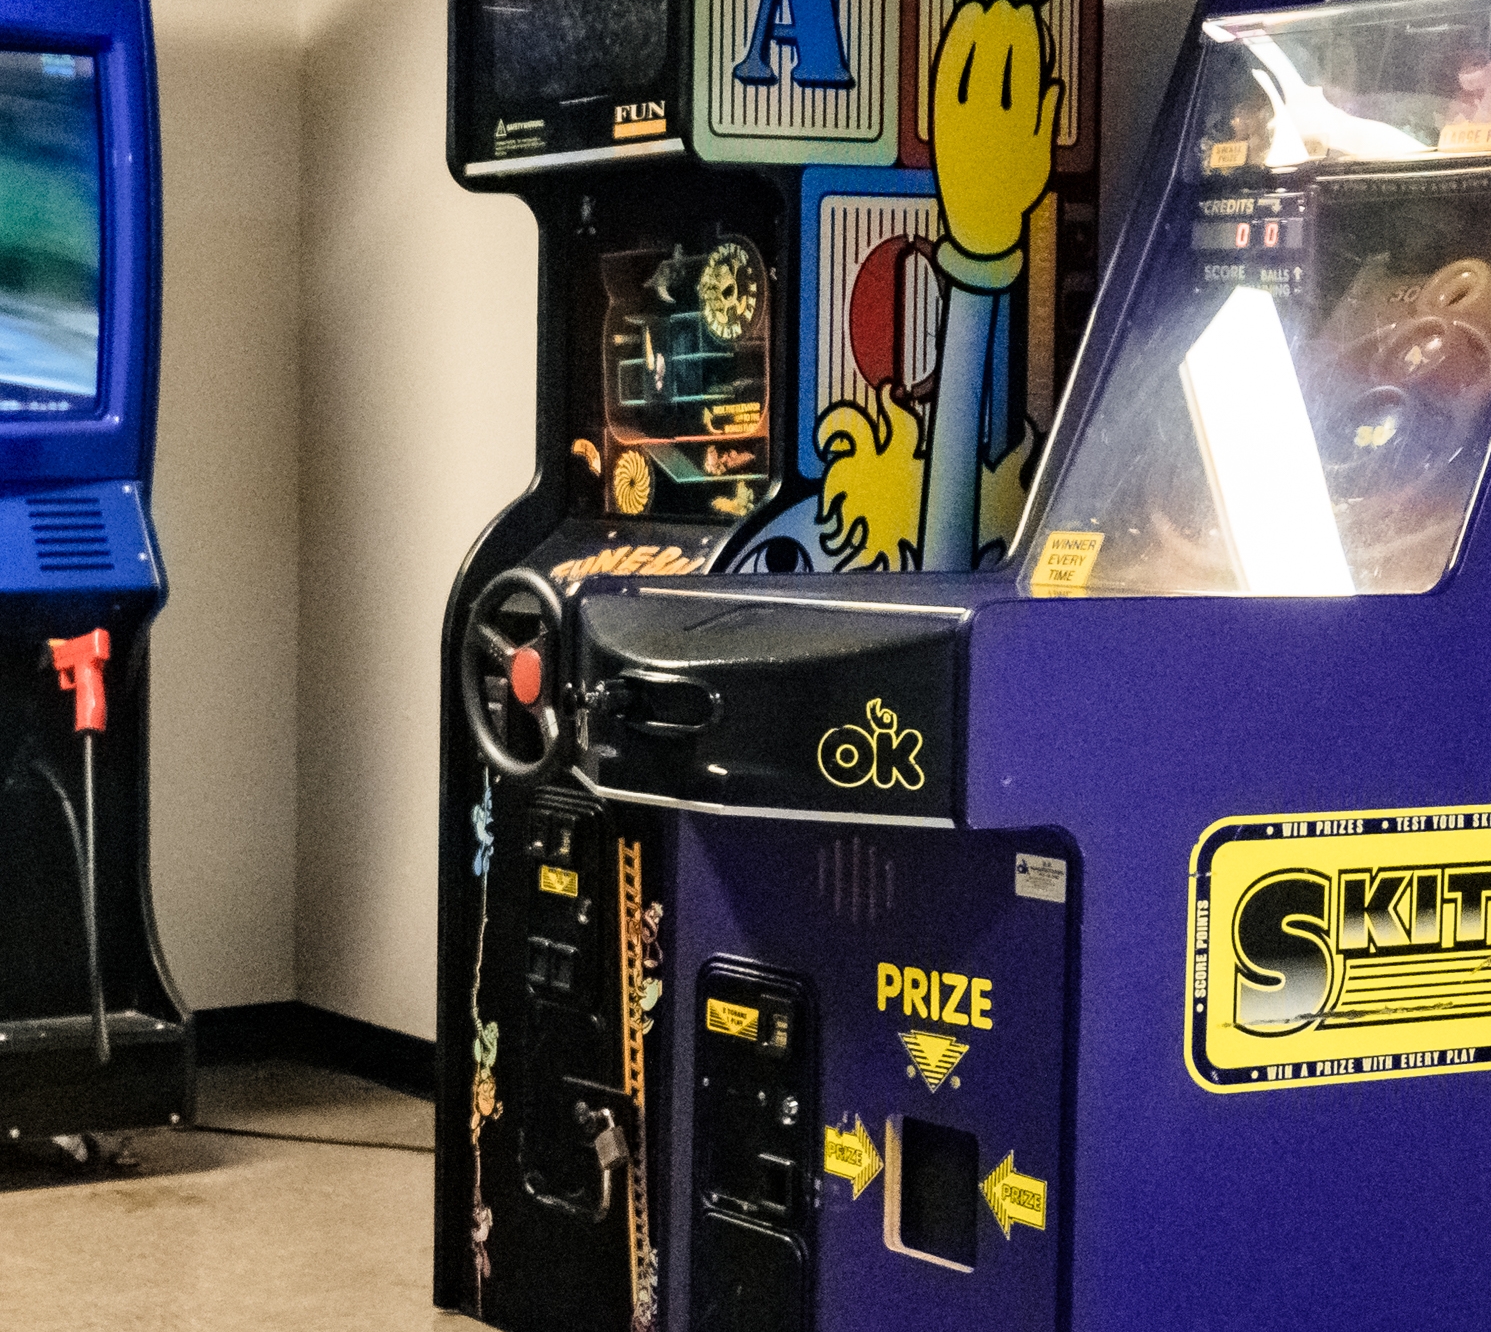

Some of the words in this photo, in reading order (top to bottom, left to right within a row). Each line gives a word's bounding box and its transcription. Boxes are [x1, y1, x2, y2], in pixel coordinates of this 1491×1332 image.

[614, 100, 666, 123] FUN
[1204, 198, 1256, 215] CREDITS
[1235, 222, 1251, 248] 0
[1264, 222, 1280, 248] 0
[1204, 265, 1247, 282] SCORE
[1260, 269, 1291, 283] BALLS
[1051, 538, 1097, 551] WINNER
[1047, 553, 1087, 566] EVERY
[1048, 569, 1076, 582] TIME
[817, 724, 925, 791] OK
[1281, 821, 1309, 837] WIN
[1315, 819, 1365, 836] PRIZES
[1395, 815, 1428, 831] TEST
[1432, 814, 1465, 829] YOUR
[1196, 899, 1209, 949] POINTS
[1194, 953, 1207, 998] SCORE
[877, 961, 993, 1030] PRIZE
[1266, 1065, 1294, 1081] WIN
[1300, 1063, 1309, 1078] A
[1316, 1059, 1355, 1076] PRIZE
[1362, 1055, 1393, 1072] WITH
[1400, 1051, 1440, 1068] EVERY
[1446, 1048, 1477, 1064] PLAY
[828, 1141, 864, 1168] PRIZE
[1001, 1182, 1042, 1213] PRIZE
